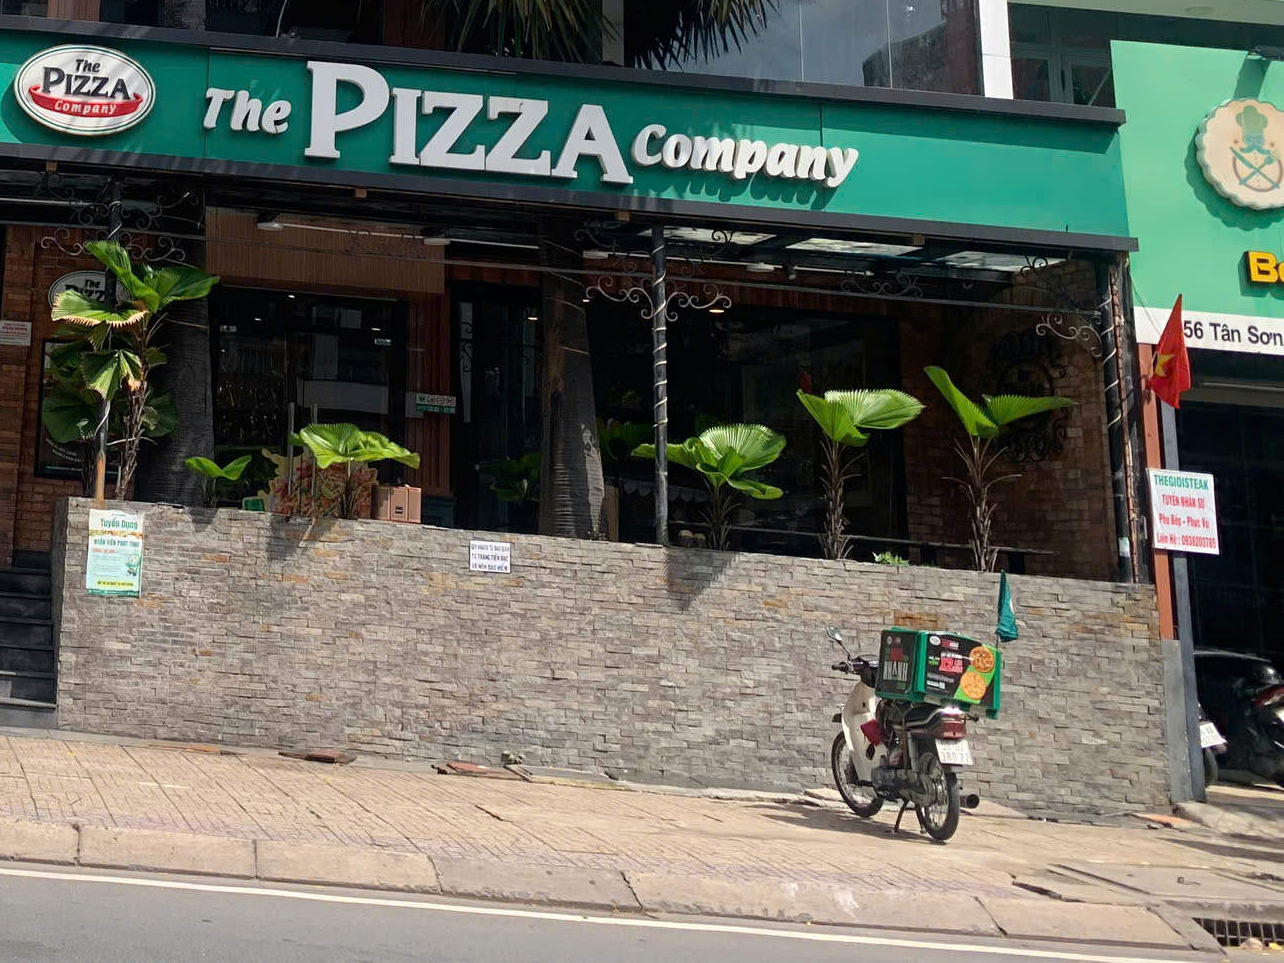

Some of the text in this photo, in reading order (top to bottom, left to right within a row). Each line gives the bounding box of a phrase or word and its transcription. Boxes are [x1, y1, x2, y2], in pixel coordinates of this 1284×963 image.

[42, 58, 131, 115] The PIZZA Company
[202, 60, 860, 188] The PIZZA Company
[84, 279, 101, 289] The
[1209, 321, 1242, 343] Tân
[1248, 325, 1284, 347] Sơn
[1153, 474, 1209, 491] THEGIOISTEAK
